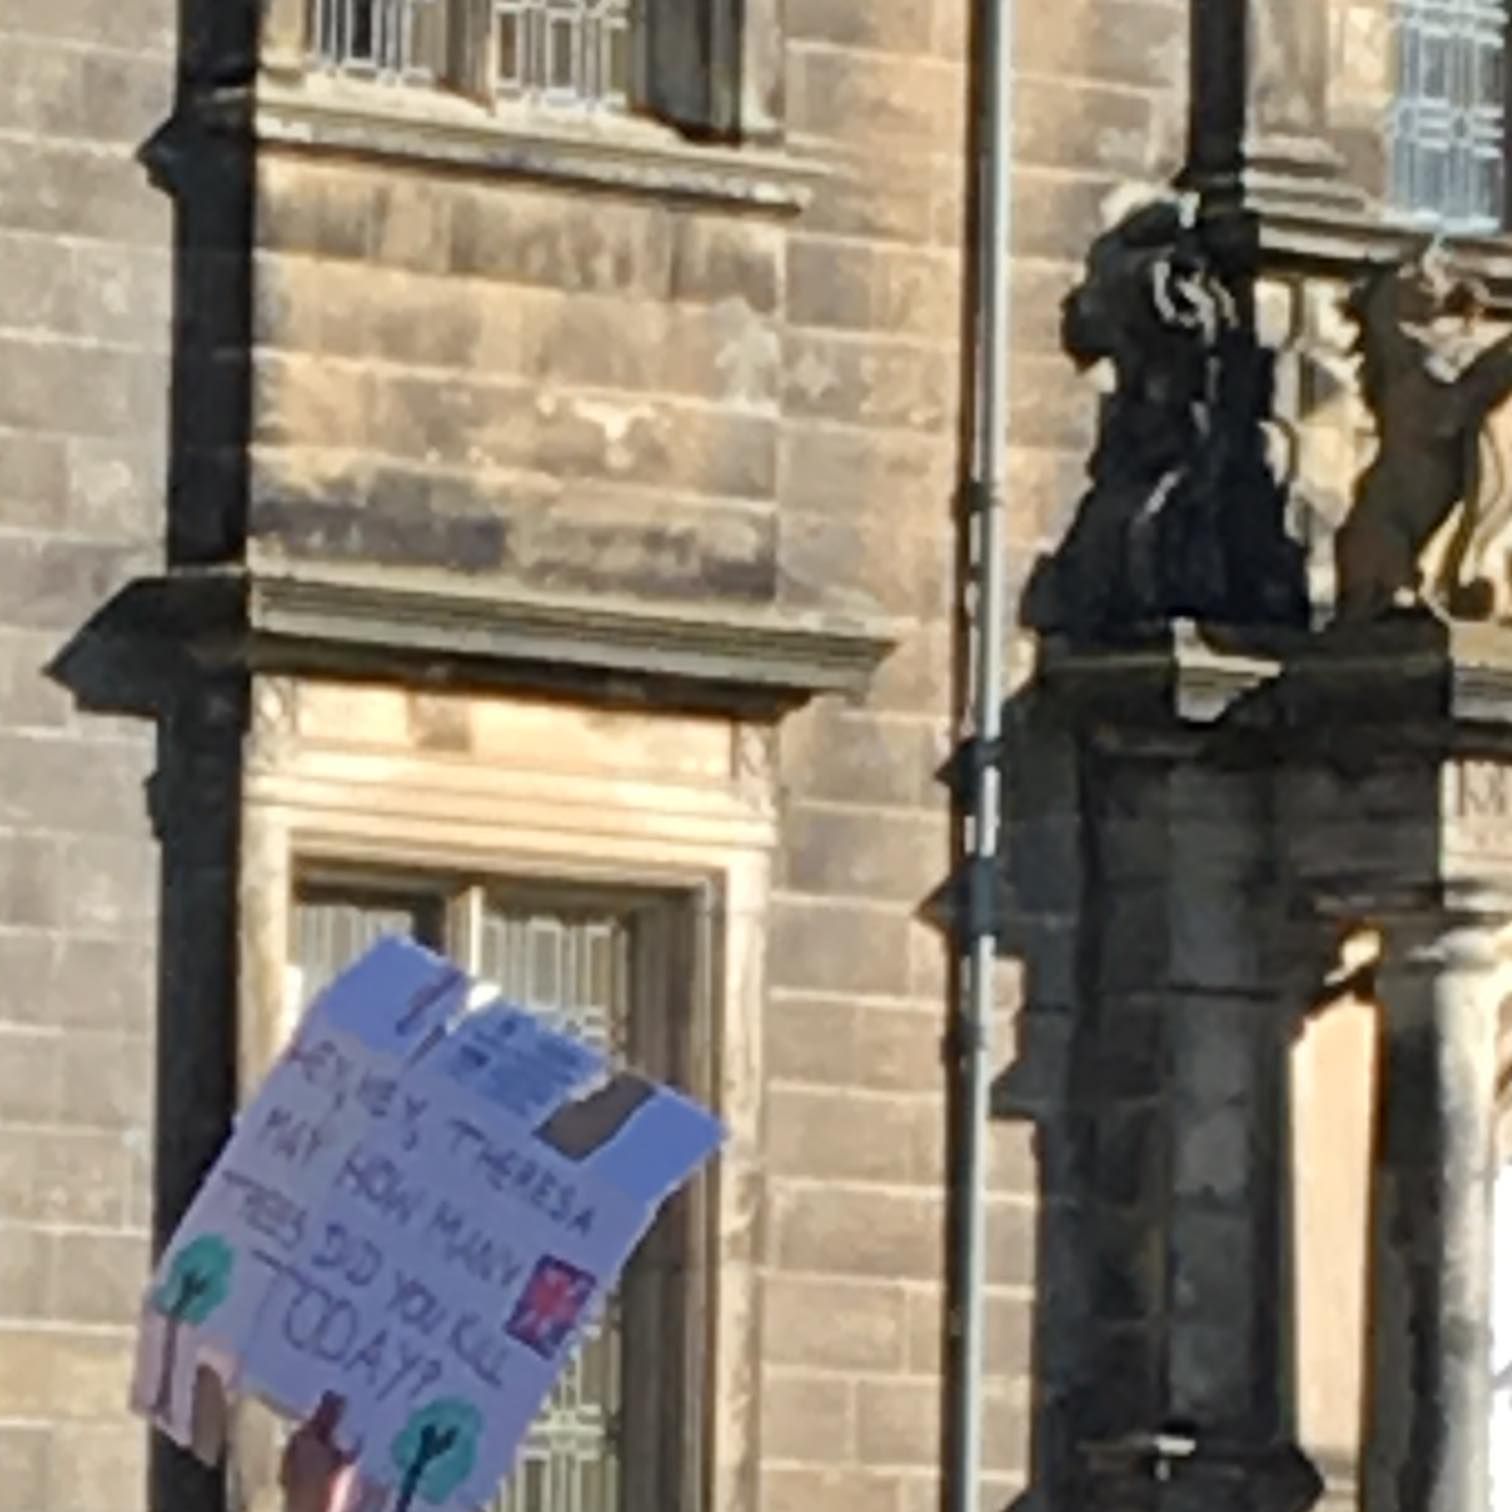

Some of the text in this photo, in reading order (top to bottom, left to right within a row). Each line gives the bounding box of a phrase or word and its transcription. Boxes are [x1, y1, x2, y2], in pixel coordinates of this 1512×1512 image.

[257, 1106, 523, 1288] MAY HOW MANY
[448, 1116, 595, 1239] THERESA
[248, 1248, 443, 1400] TODAY?
[310, 1219, 384, 1288] DID
[386, 1269, 448, 1337] YOU
